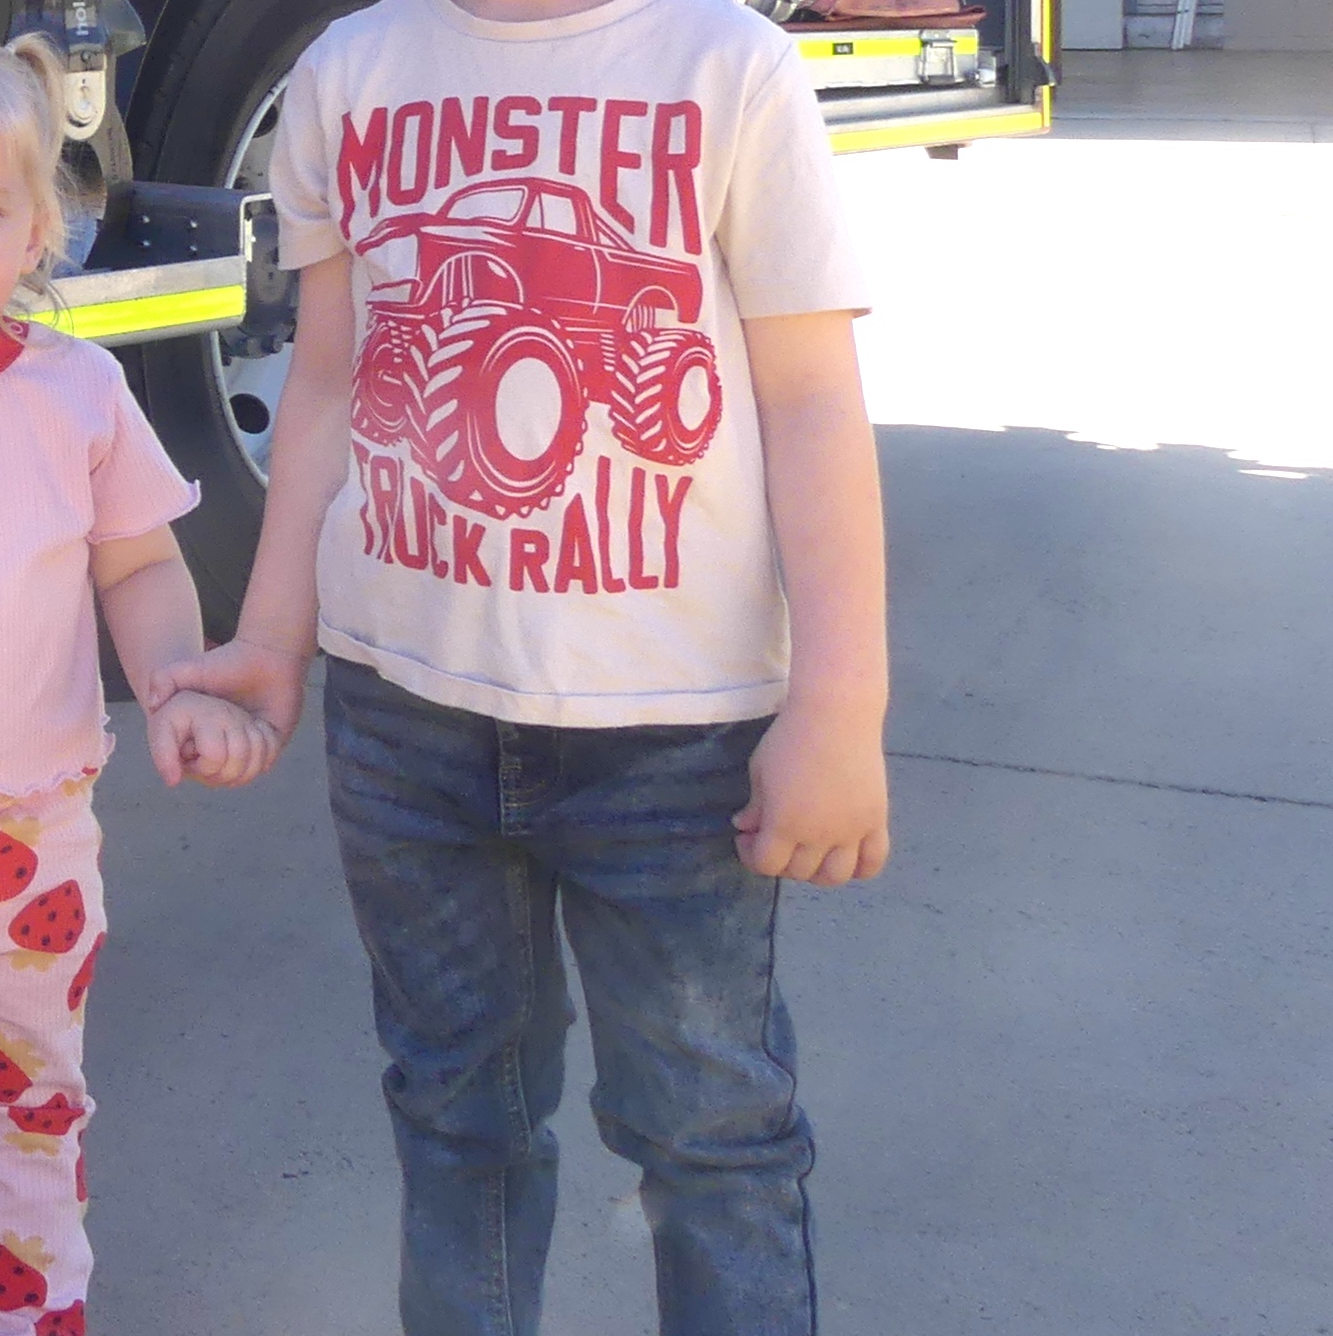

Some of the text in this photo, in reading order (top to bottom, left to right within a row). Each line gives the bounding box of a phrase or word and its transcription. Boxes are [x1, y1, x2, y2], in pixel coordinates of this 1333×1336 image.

[336, 95, 703, 257] MONSTER
[350, 438, 694, 595] TRUCK RALLY
